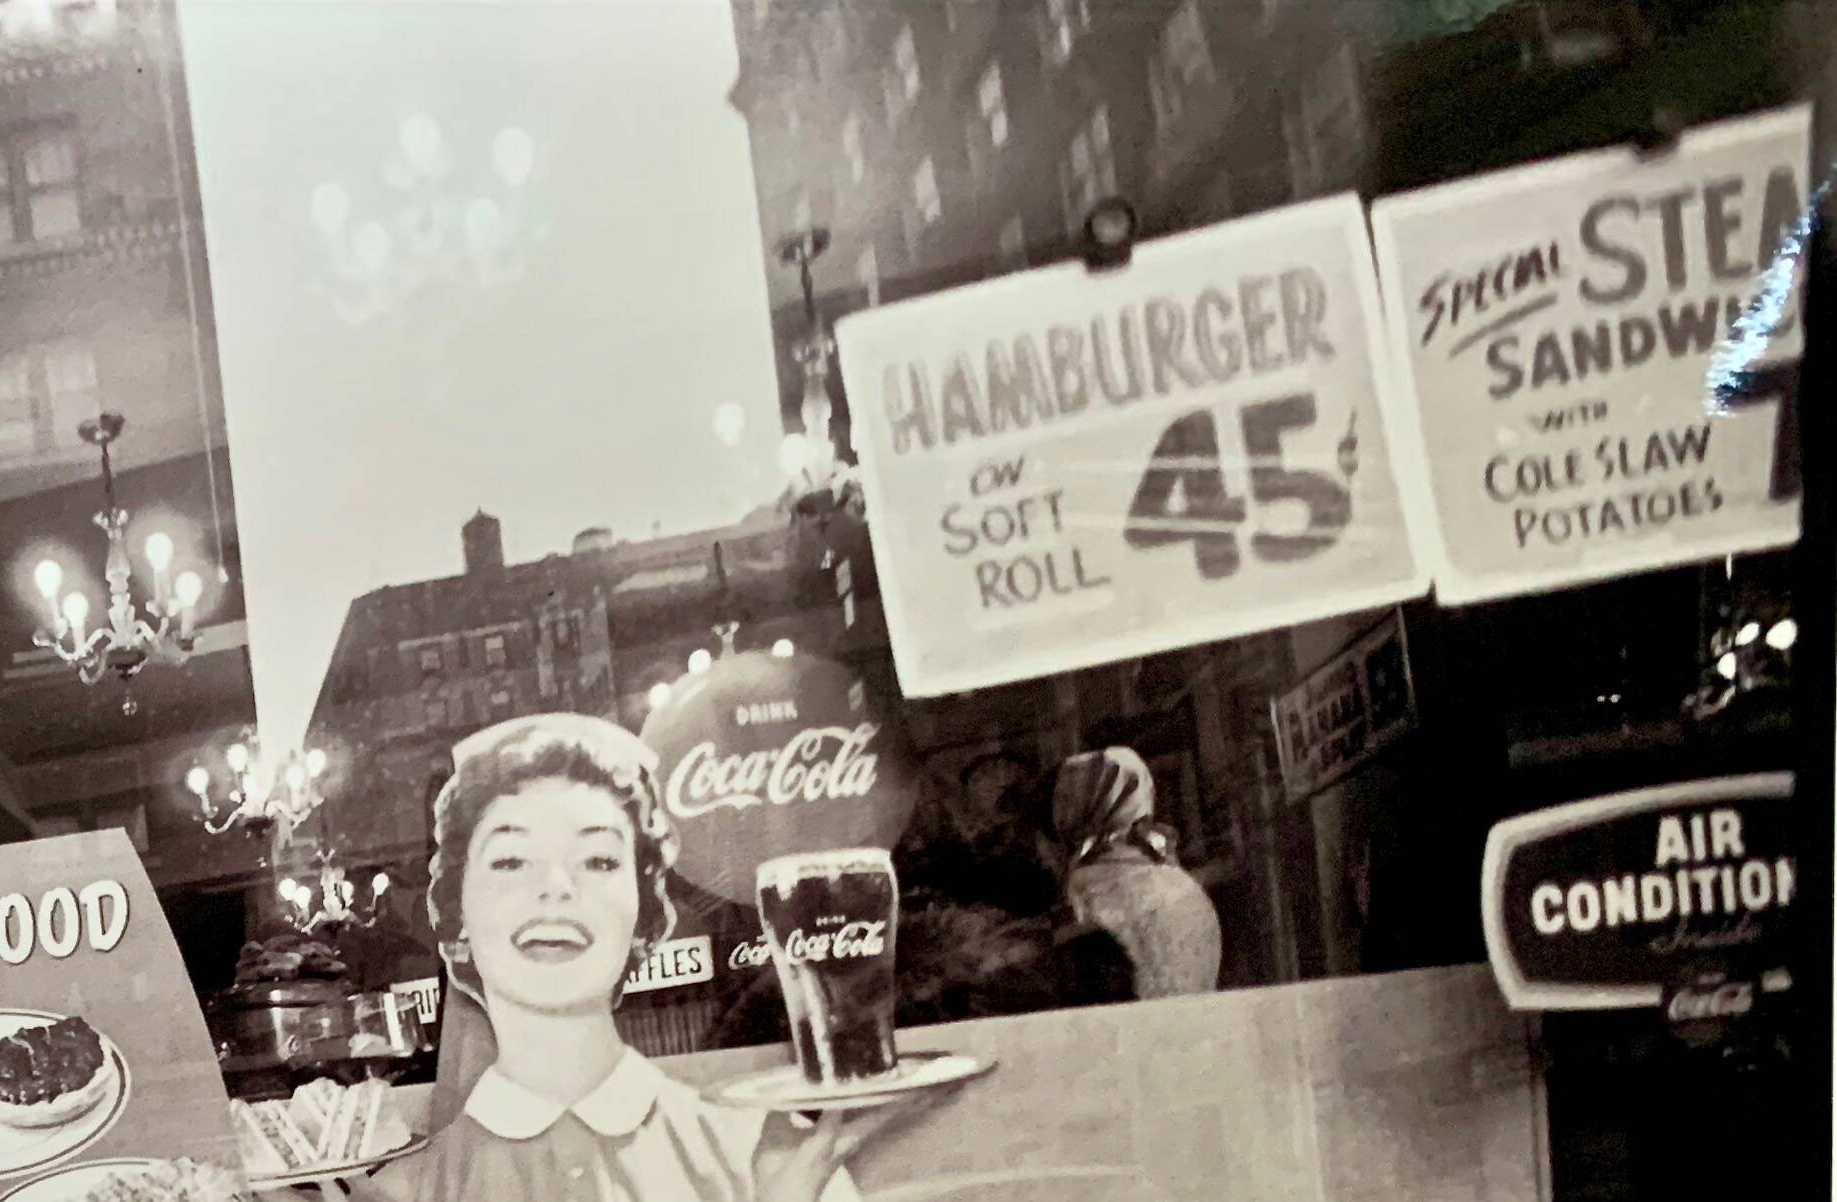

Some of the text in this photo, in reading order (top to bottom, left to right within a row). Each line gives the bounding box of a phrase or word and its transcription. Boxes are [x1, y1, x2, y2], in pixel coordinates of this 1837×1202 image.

[882, 266, 1335, 454] HAMBURGER
[969, 456, 1027, 497] ON
[939, 490, 1064, 556] SOFT
[1515, 476, 1724, 549] POTATOES
[974, 548, 1111, 608] ROLL
[665, 721, 882, 819] Coca-Cola
[1654, 808, 1746, 868] AIR
